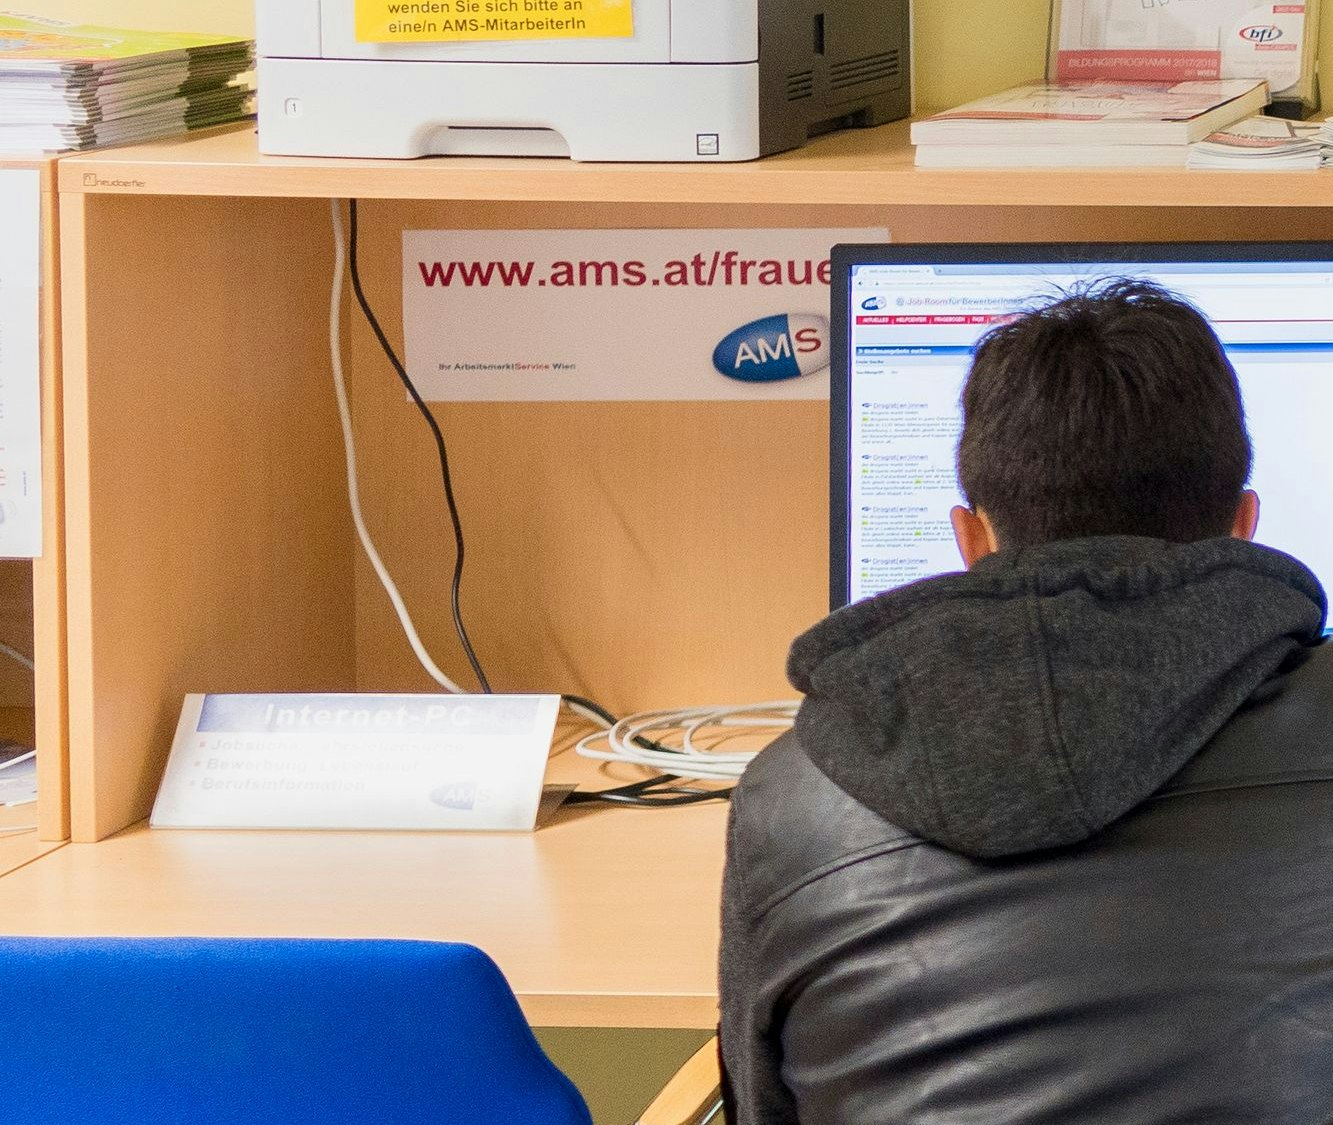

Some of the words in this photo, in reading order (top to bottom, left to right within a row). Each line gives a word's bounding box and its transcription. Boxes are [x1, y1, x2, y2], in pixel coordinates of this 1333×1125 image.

[388, 1, 451, 14] wenden
[455, 0, 481, 13] Sie
[486, 0, 518, 12] sich
[524, 0, 557, 12] bitte
[564, 1, 583, 11] an
[388, 20, 437, 34] eine/n
[442, 18, 586, 33] AMS-MitarbeiterIn
[1249, 25, 1275, 42] bfi
[1068, 58, 1172, 68] BILDUNGSPROGRAMM
[734, 328, 823, 368] AMS
[263, 702, 475, 727] Internet-PC
[442, 788, 491, 804] AMS
